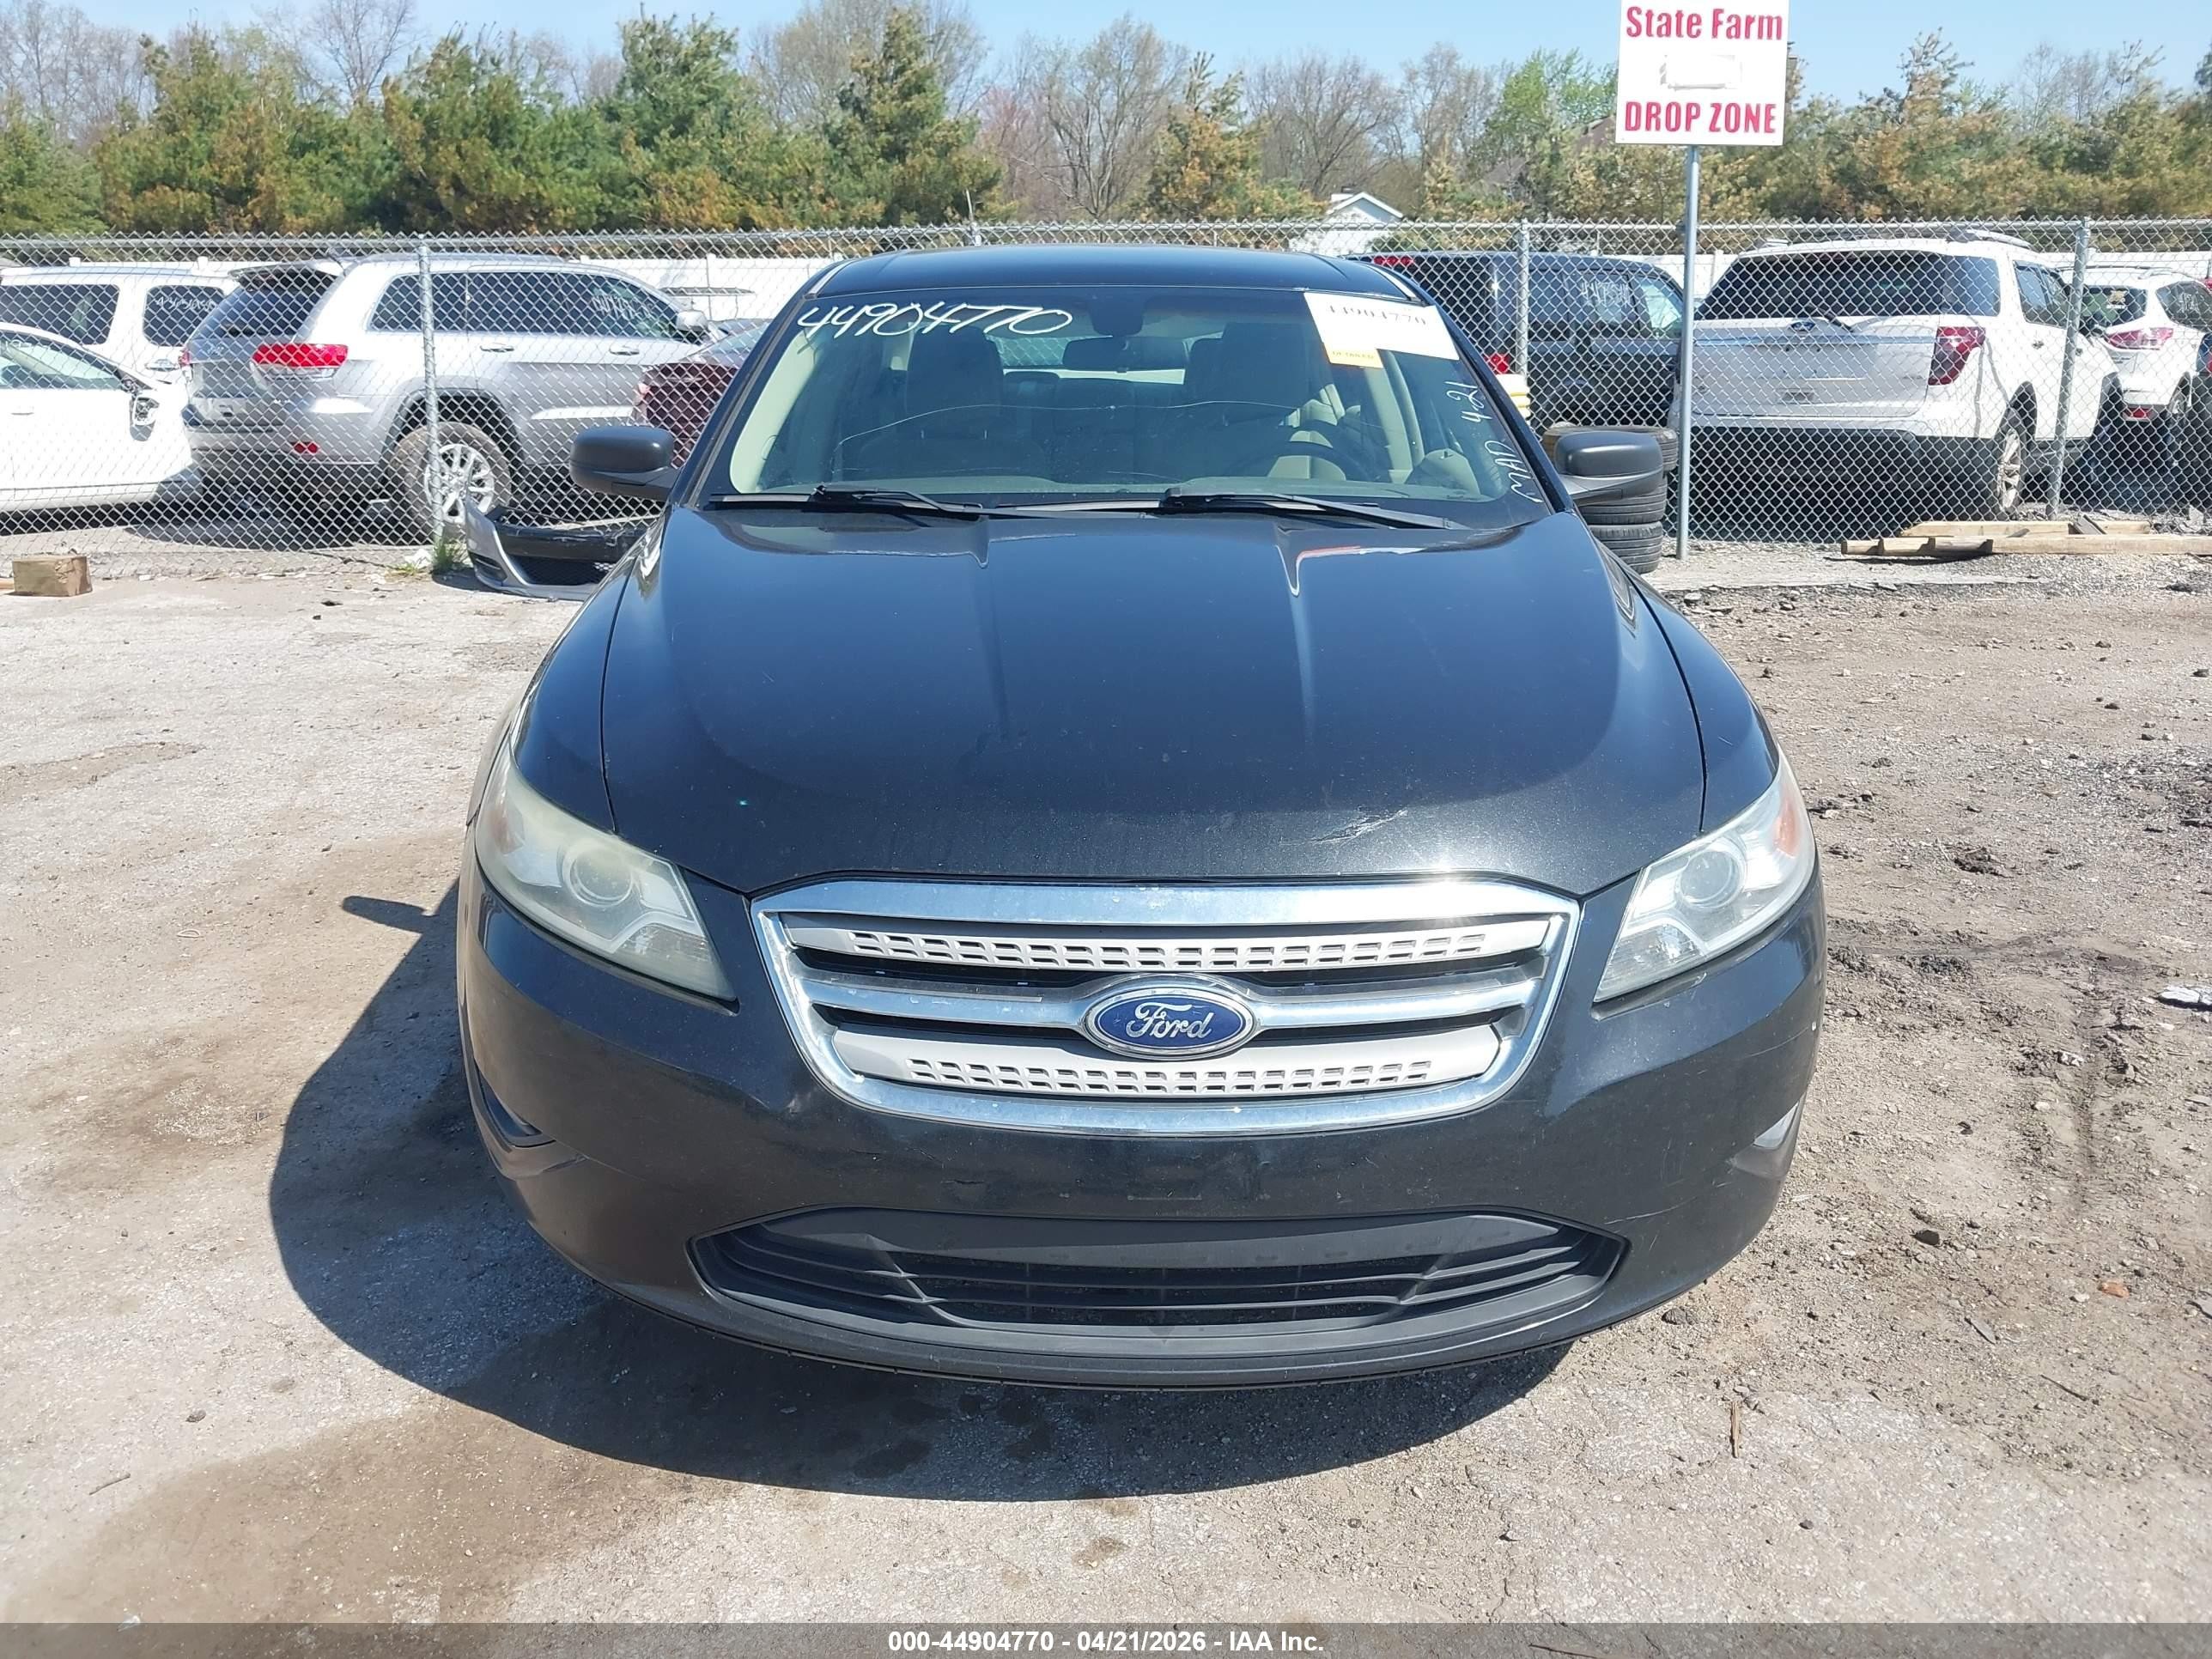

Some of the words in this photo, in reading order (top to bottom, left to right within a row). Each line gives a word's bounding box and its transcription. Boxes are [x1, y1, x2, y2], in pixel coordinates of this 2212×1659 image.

[1626, 5, 1702, 39] State
[1711, 8, 1783, 40] Farm
[1625, 101, 1701, 132] DROP
[1708, 102, 1777, 134] ZONE
[797, 301, 1073, 338] 44904770
[1125, 1001, 1214, 1039] Ford
